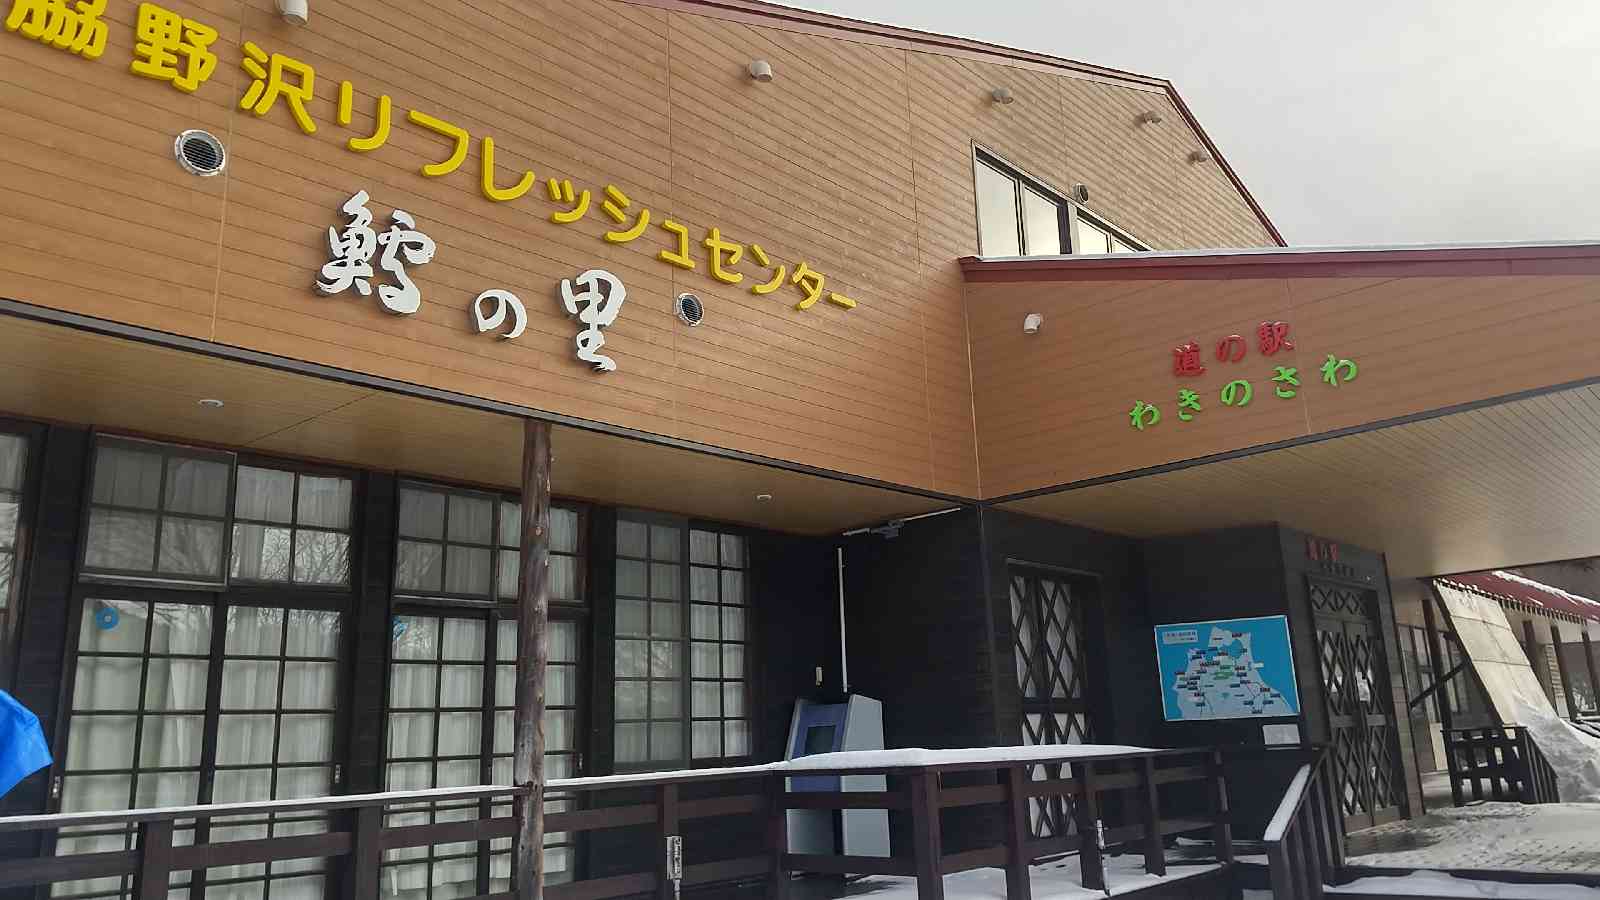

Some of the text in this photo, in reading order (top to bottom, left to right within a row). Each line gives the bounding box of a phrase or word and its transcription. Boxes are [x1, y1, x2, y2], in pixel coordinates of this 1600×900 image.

[315, 190, 627, 372] 鱈の里
[1172, 320, 1296, 378] 道の駅
[1129, 353, 1359, 430] わきのさわ
